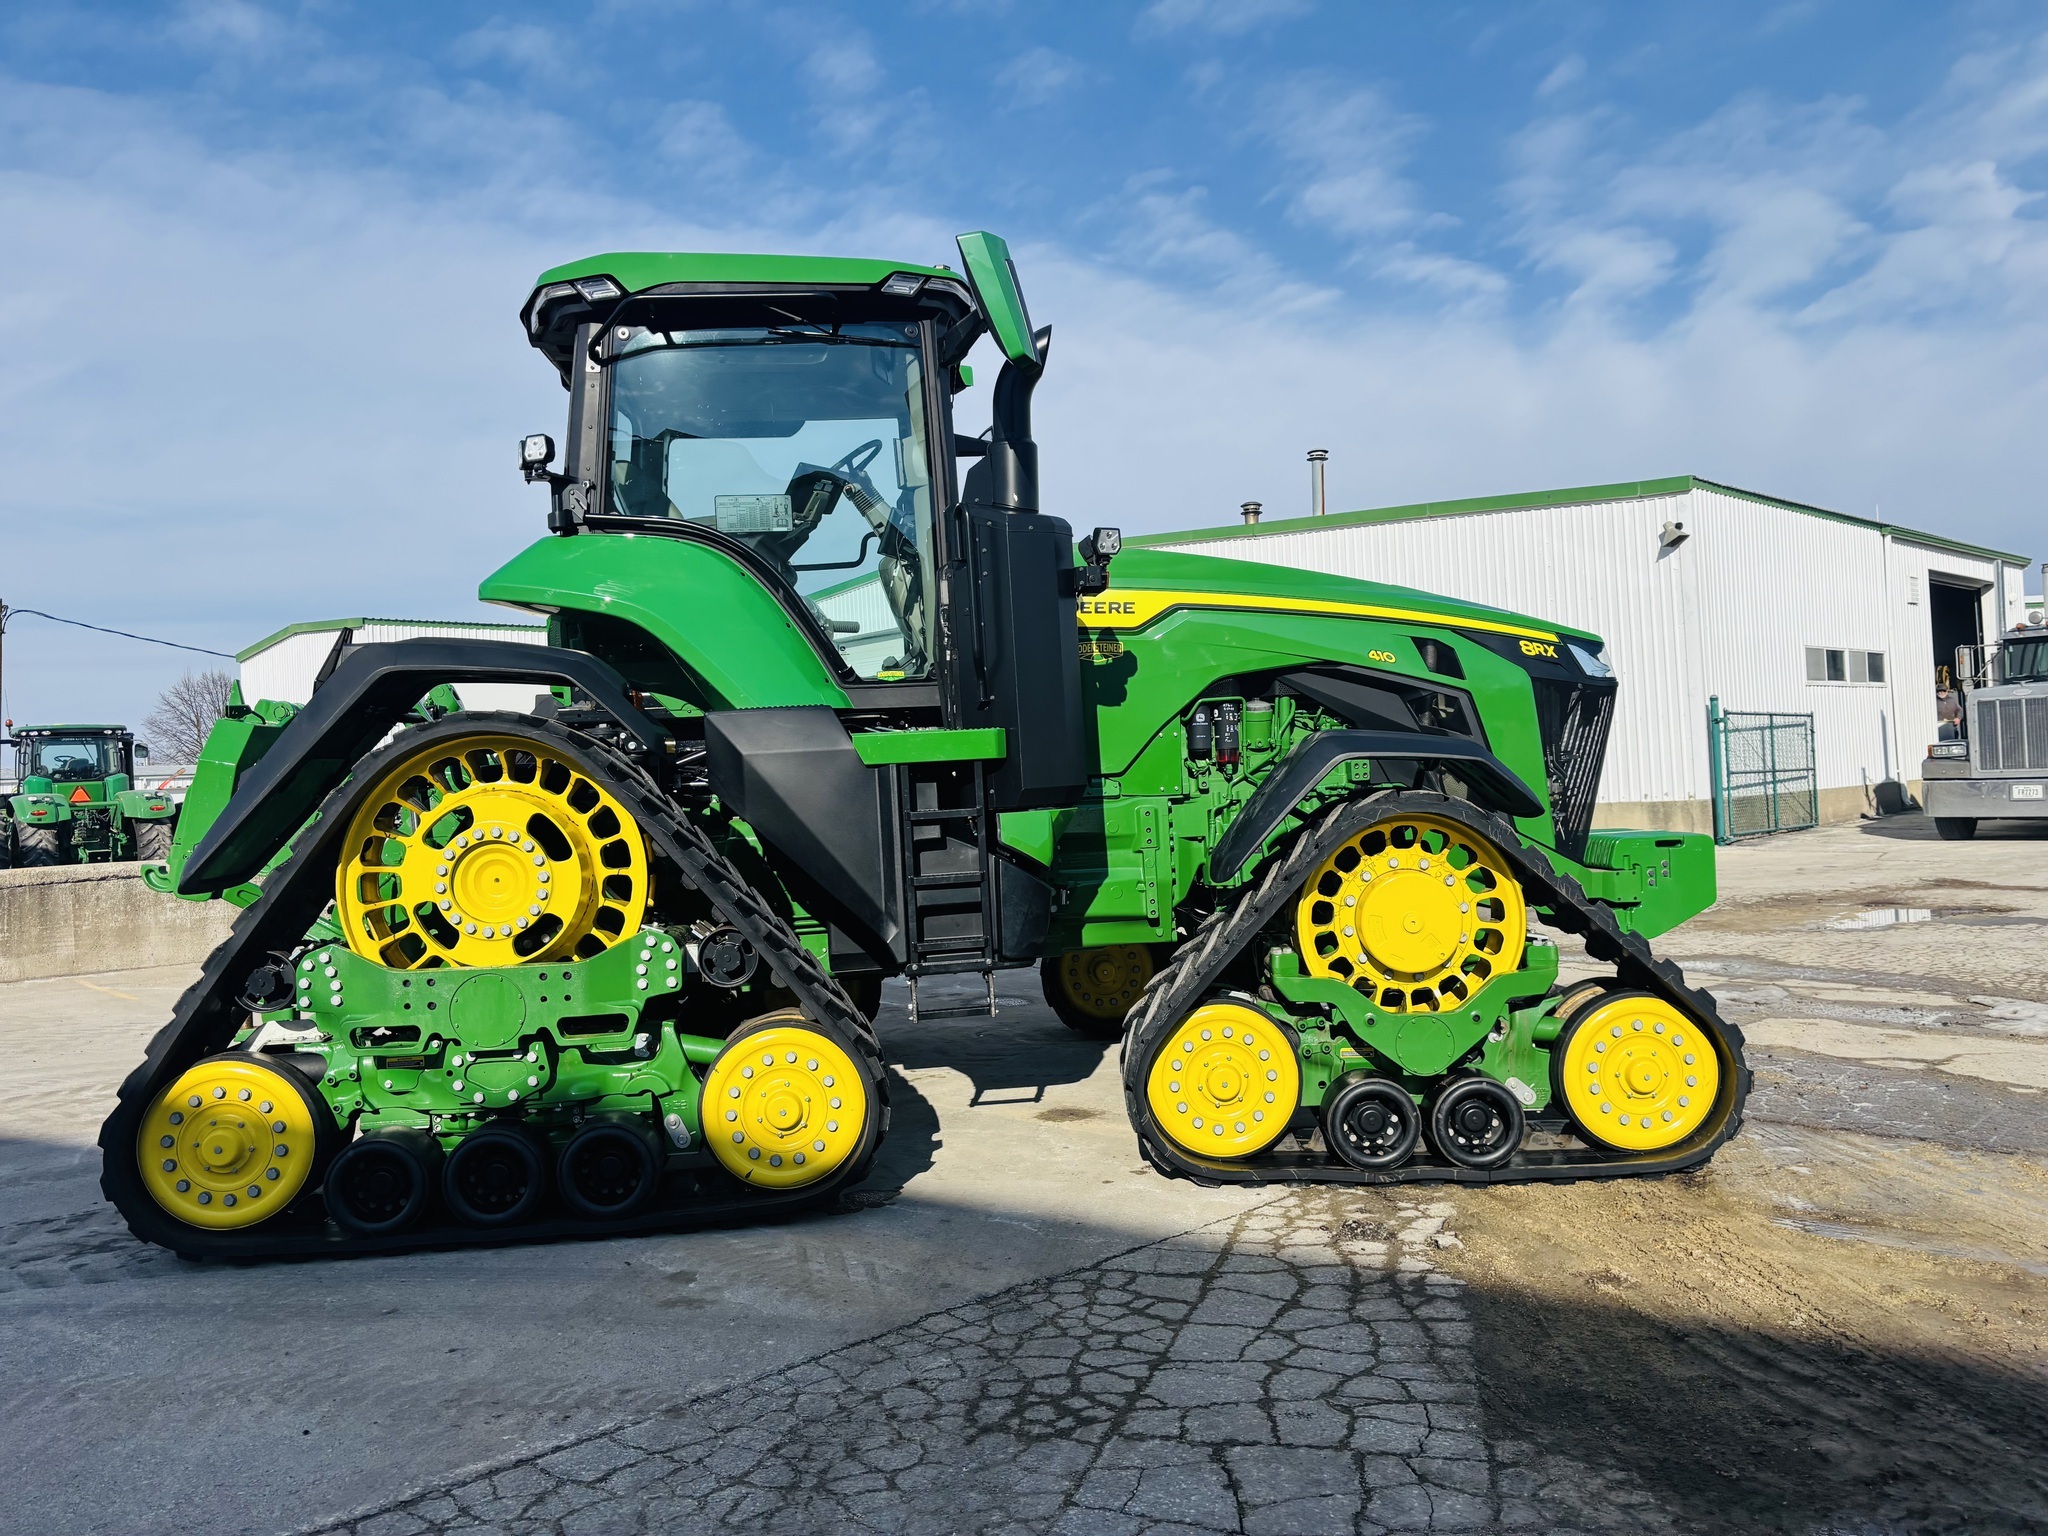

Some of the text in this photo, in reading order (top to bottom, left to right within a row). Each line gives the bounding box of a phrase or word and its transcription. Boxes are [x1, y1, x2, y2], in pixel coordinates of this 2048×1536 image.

[1077, 601, 1135, 614] EERE
[1079, 643, 1122, 653] ODENSTEINER
[1519, 640, 1558, 658] 8RX
[1368, 649, 1396, 663] 410
